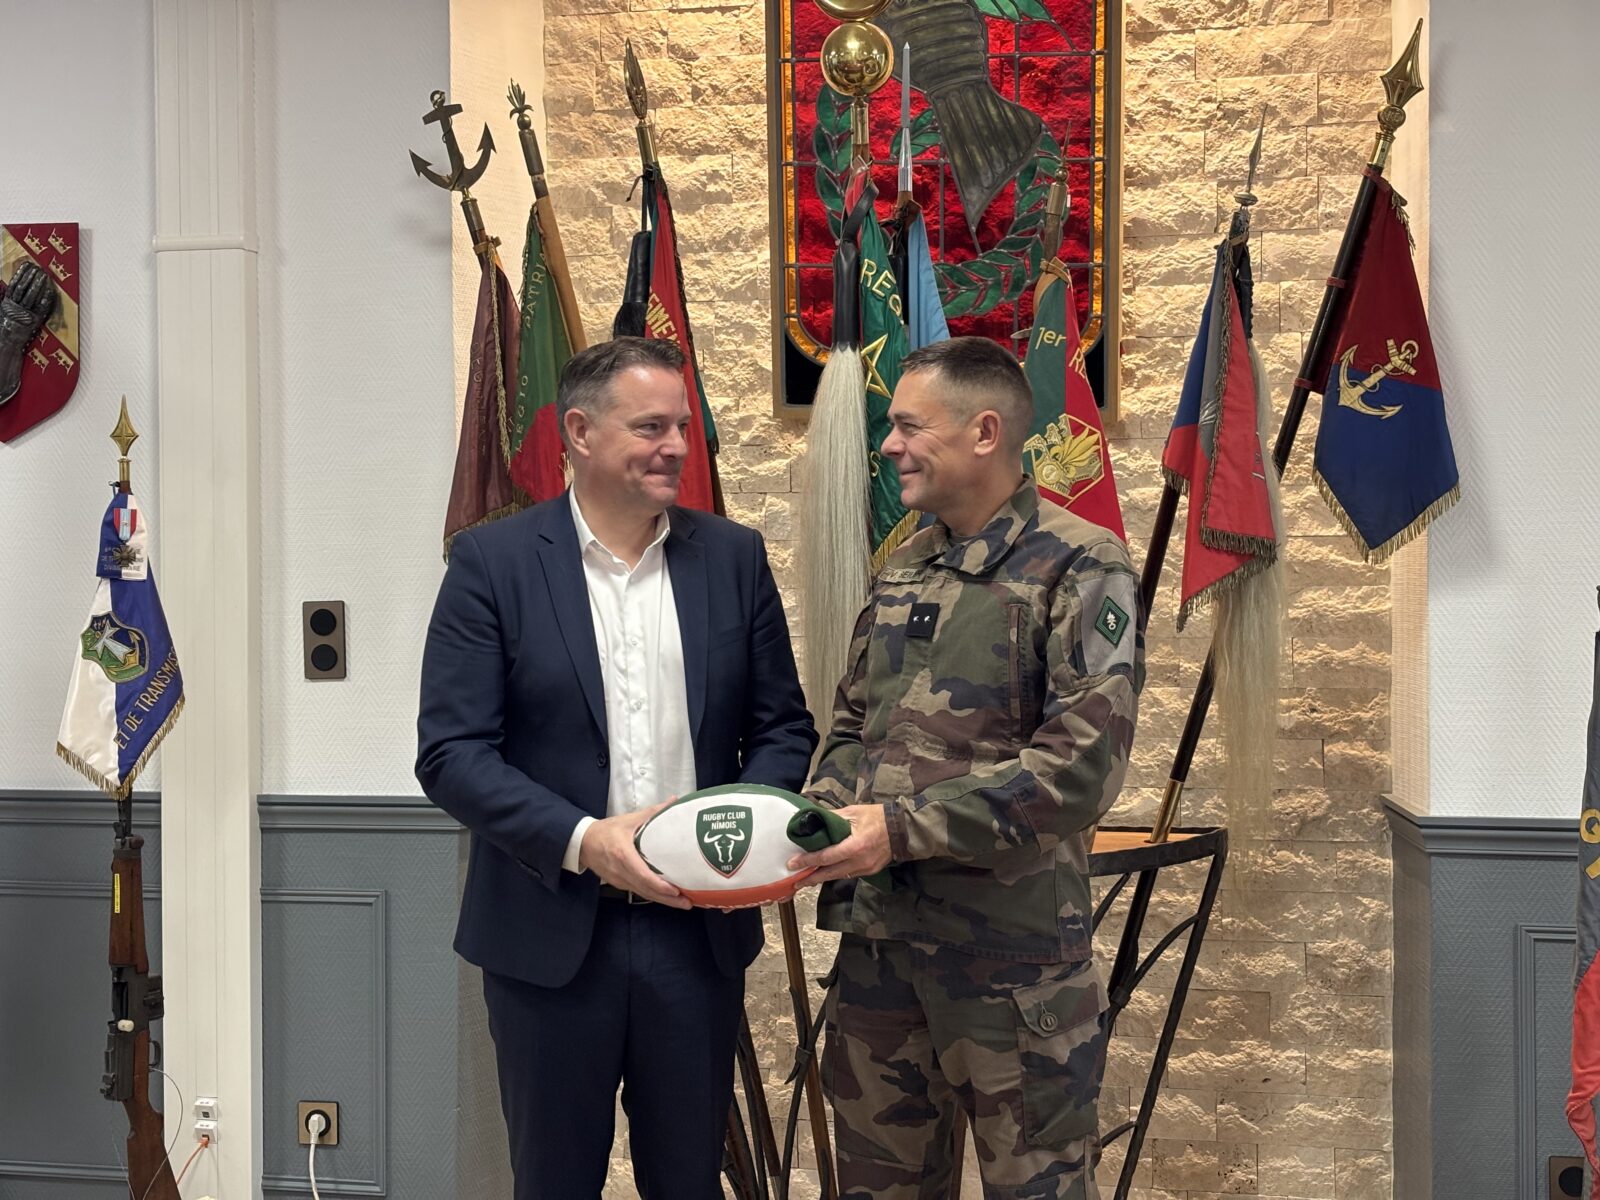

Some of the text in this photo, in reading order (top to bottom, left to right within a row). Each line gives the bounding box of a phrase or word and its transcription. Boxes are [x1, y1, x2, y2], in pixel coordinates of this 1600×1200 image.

[1035, 326, 1067, 350] 1er
[113, 645, 179, 750] ET DE TRANSMIS
[702, 811, 746, 822] RUGBY CLUB
